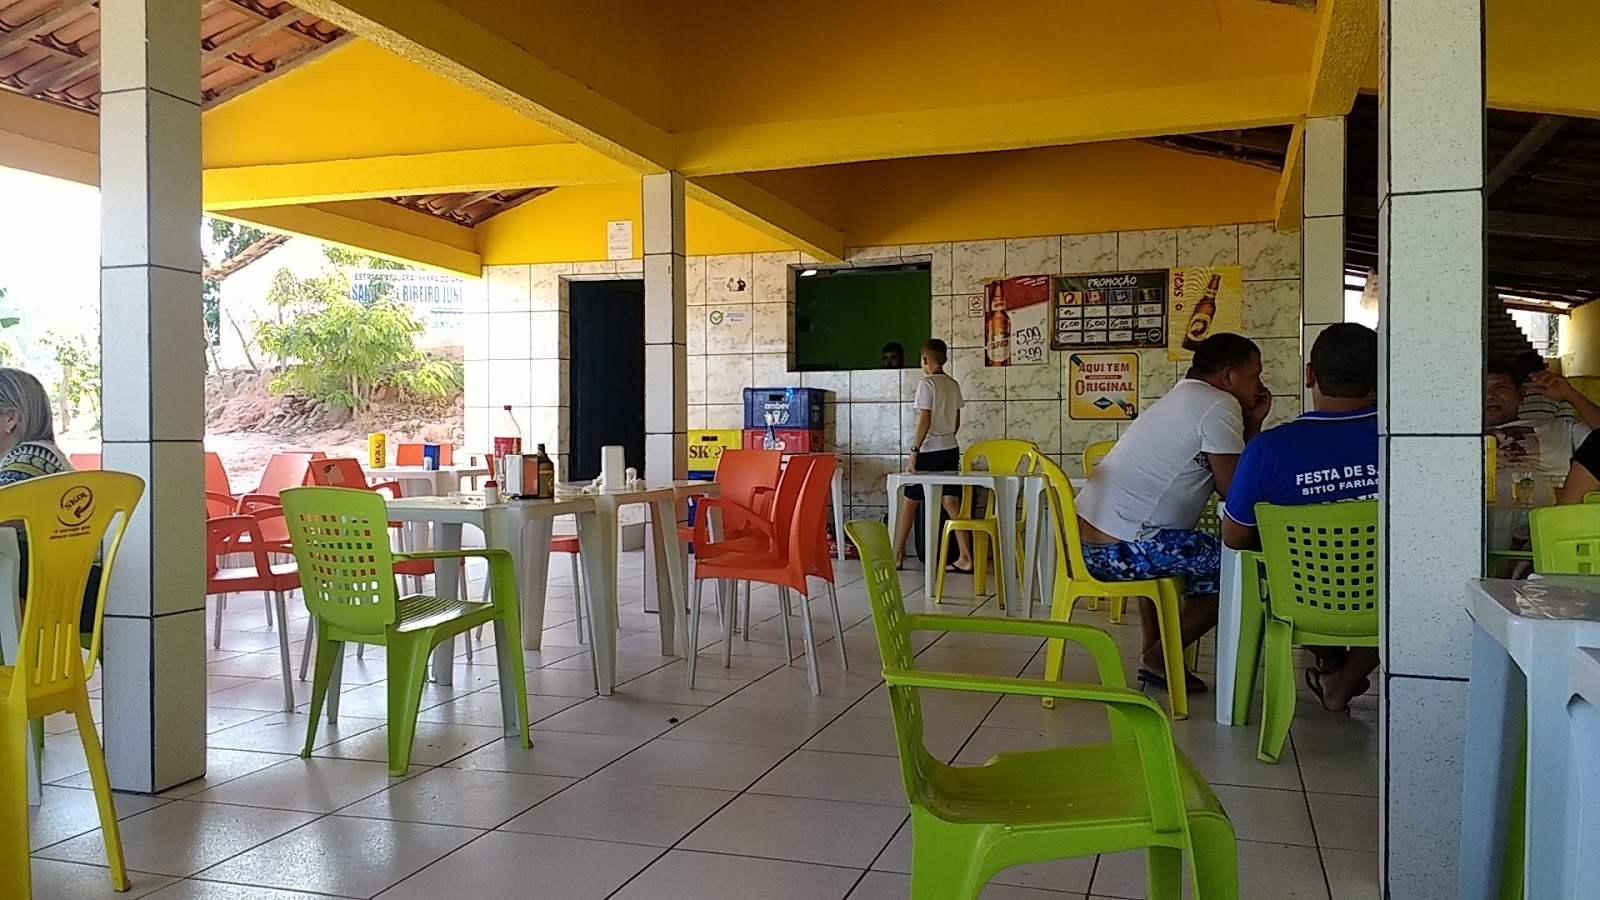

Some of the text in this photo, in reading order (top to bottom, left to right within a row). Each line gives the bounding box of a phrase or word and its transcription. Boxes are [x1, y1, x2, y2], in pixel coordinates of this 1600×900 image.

[1087, 274, 1138, 288] PROMOÇÃO
[1078, 363, 1130, 373] AQUI TEM
[1075, 379, 1135, 396] ORIGINAL
[764, 401, 790, 410] ambev
[1296, 468, 1341, 486] FESTA
[1343, 465, 1363, 478] DE
[1301, 484, 1336, 496] SITIO
[64, 492, 89, 510] SKOL
